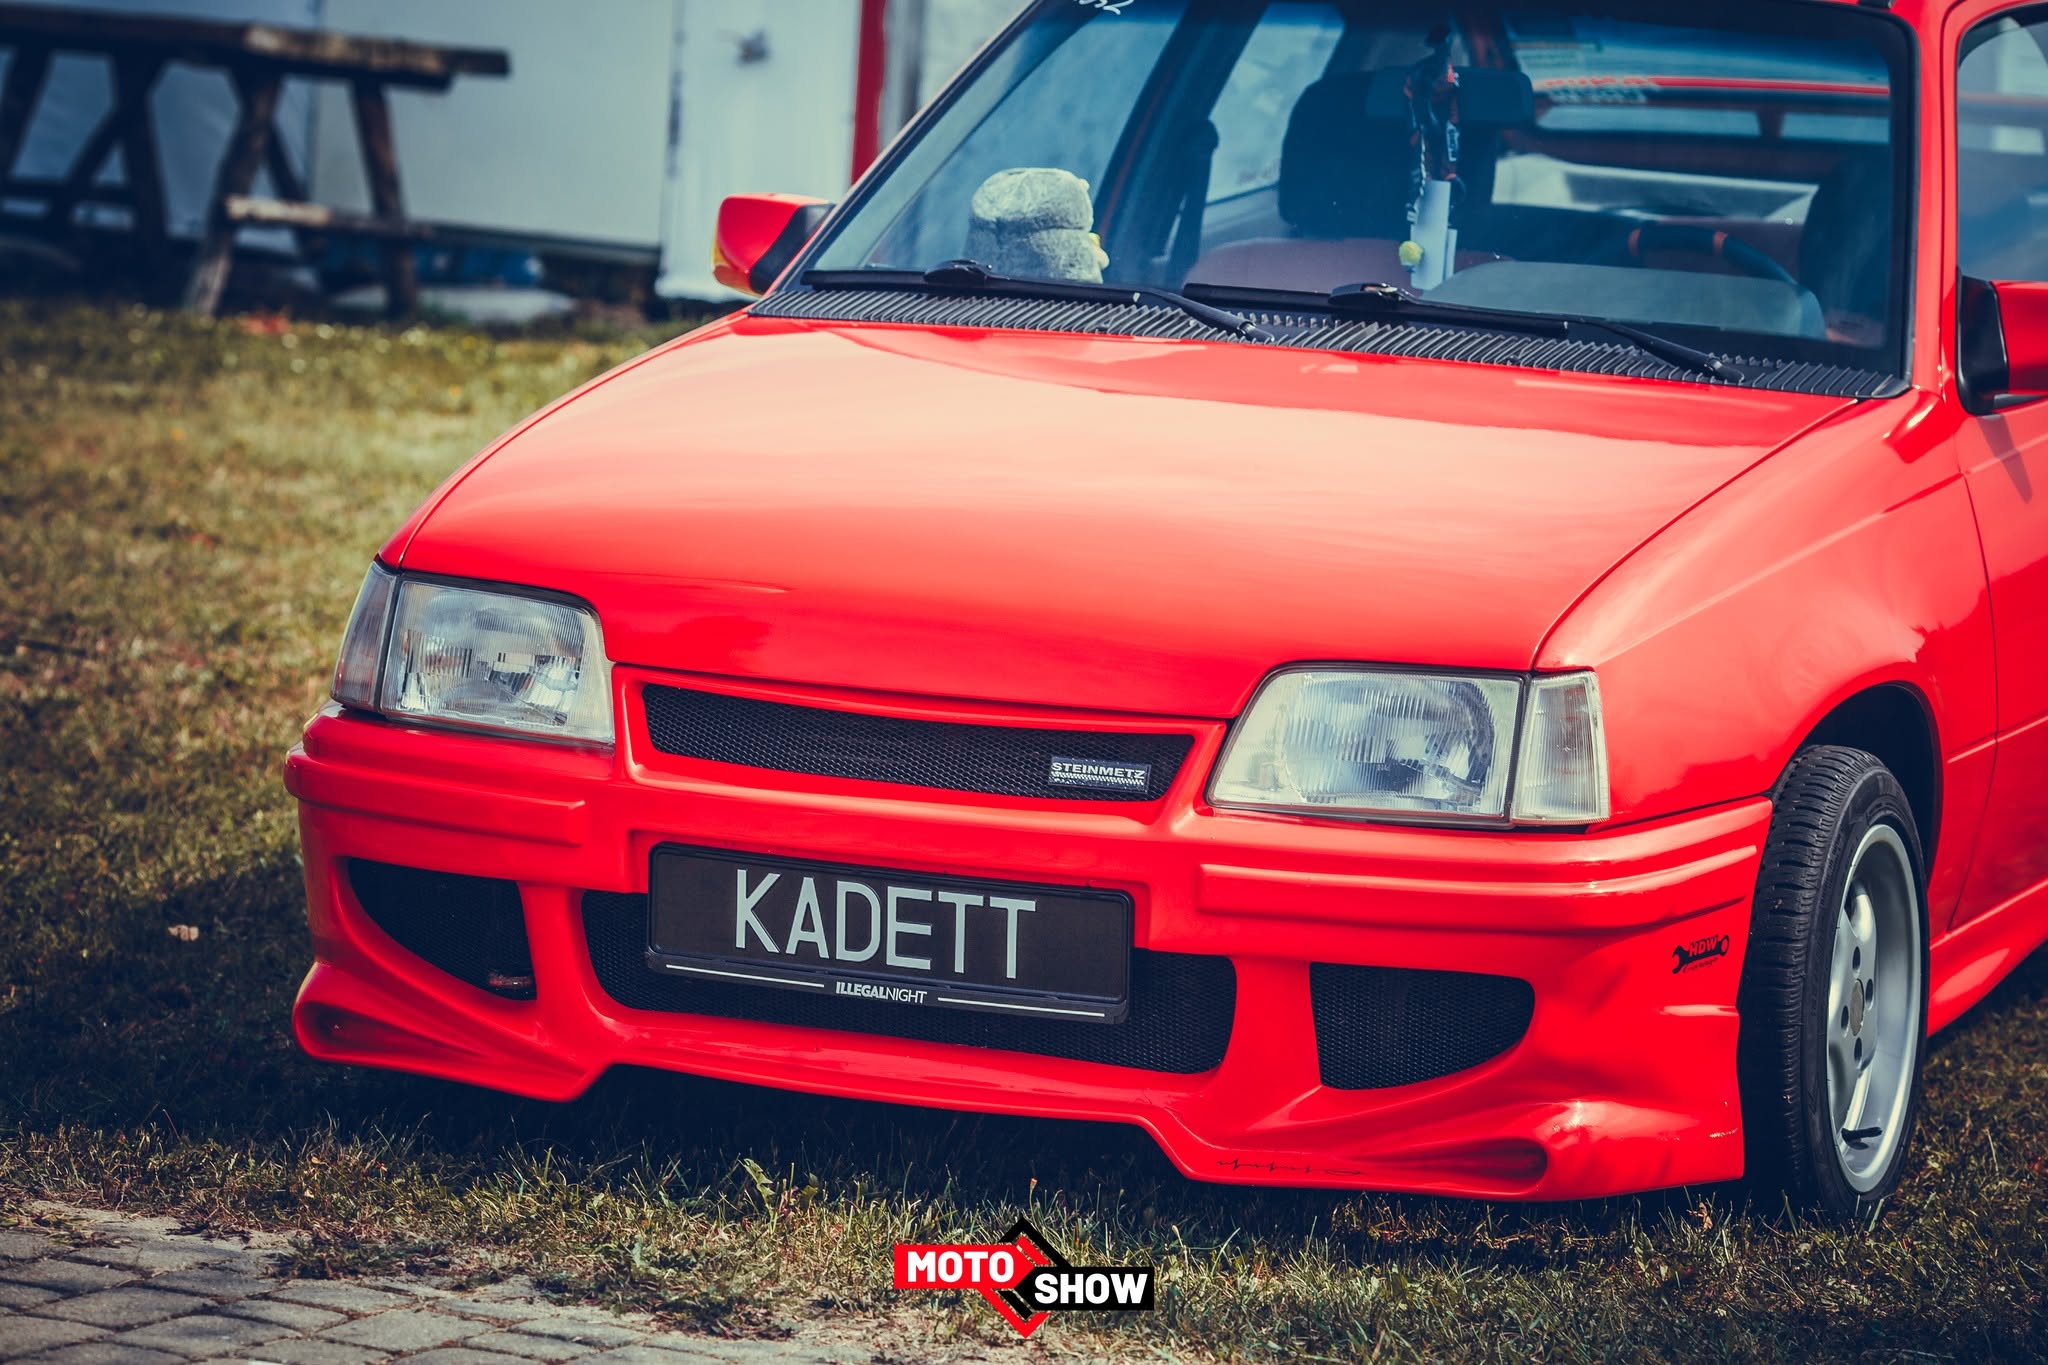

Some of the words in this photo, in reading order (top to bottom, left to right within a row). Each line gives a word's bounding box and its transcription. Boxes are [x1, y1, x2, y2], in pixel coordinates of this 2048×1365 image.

[1051, 762, 1146, 779] STEINMETZ
[735, 868, 1036, 979] KADETT
[1689, 935, 1718, 957] HDW
